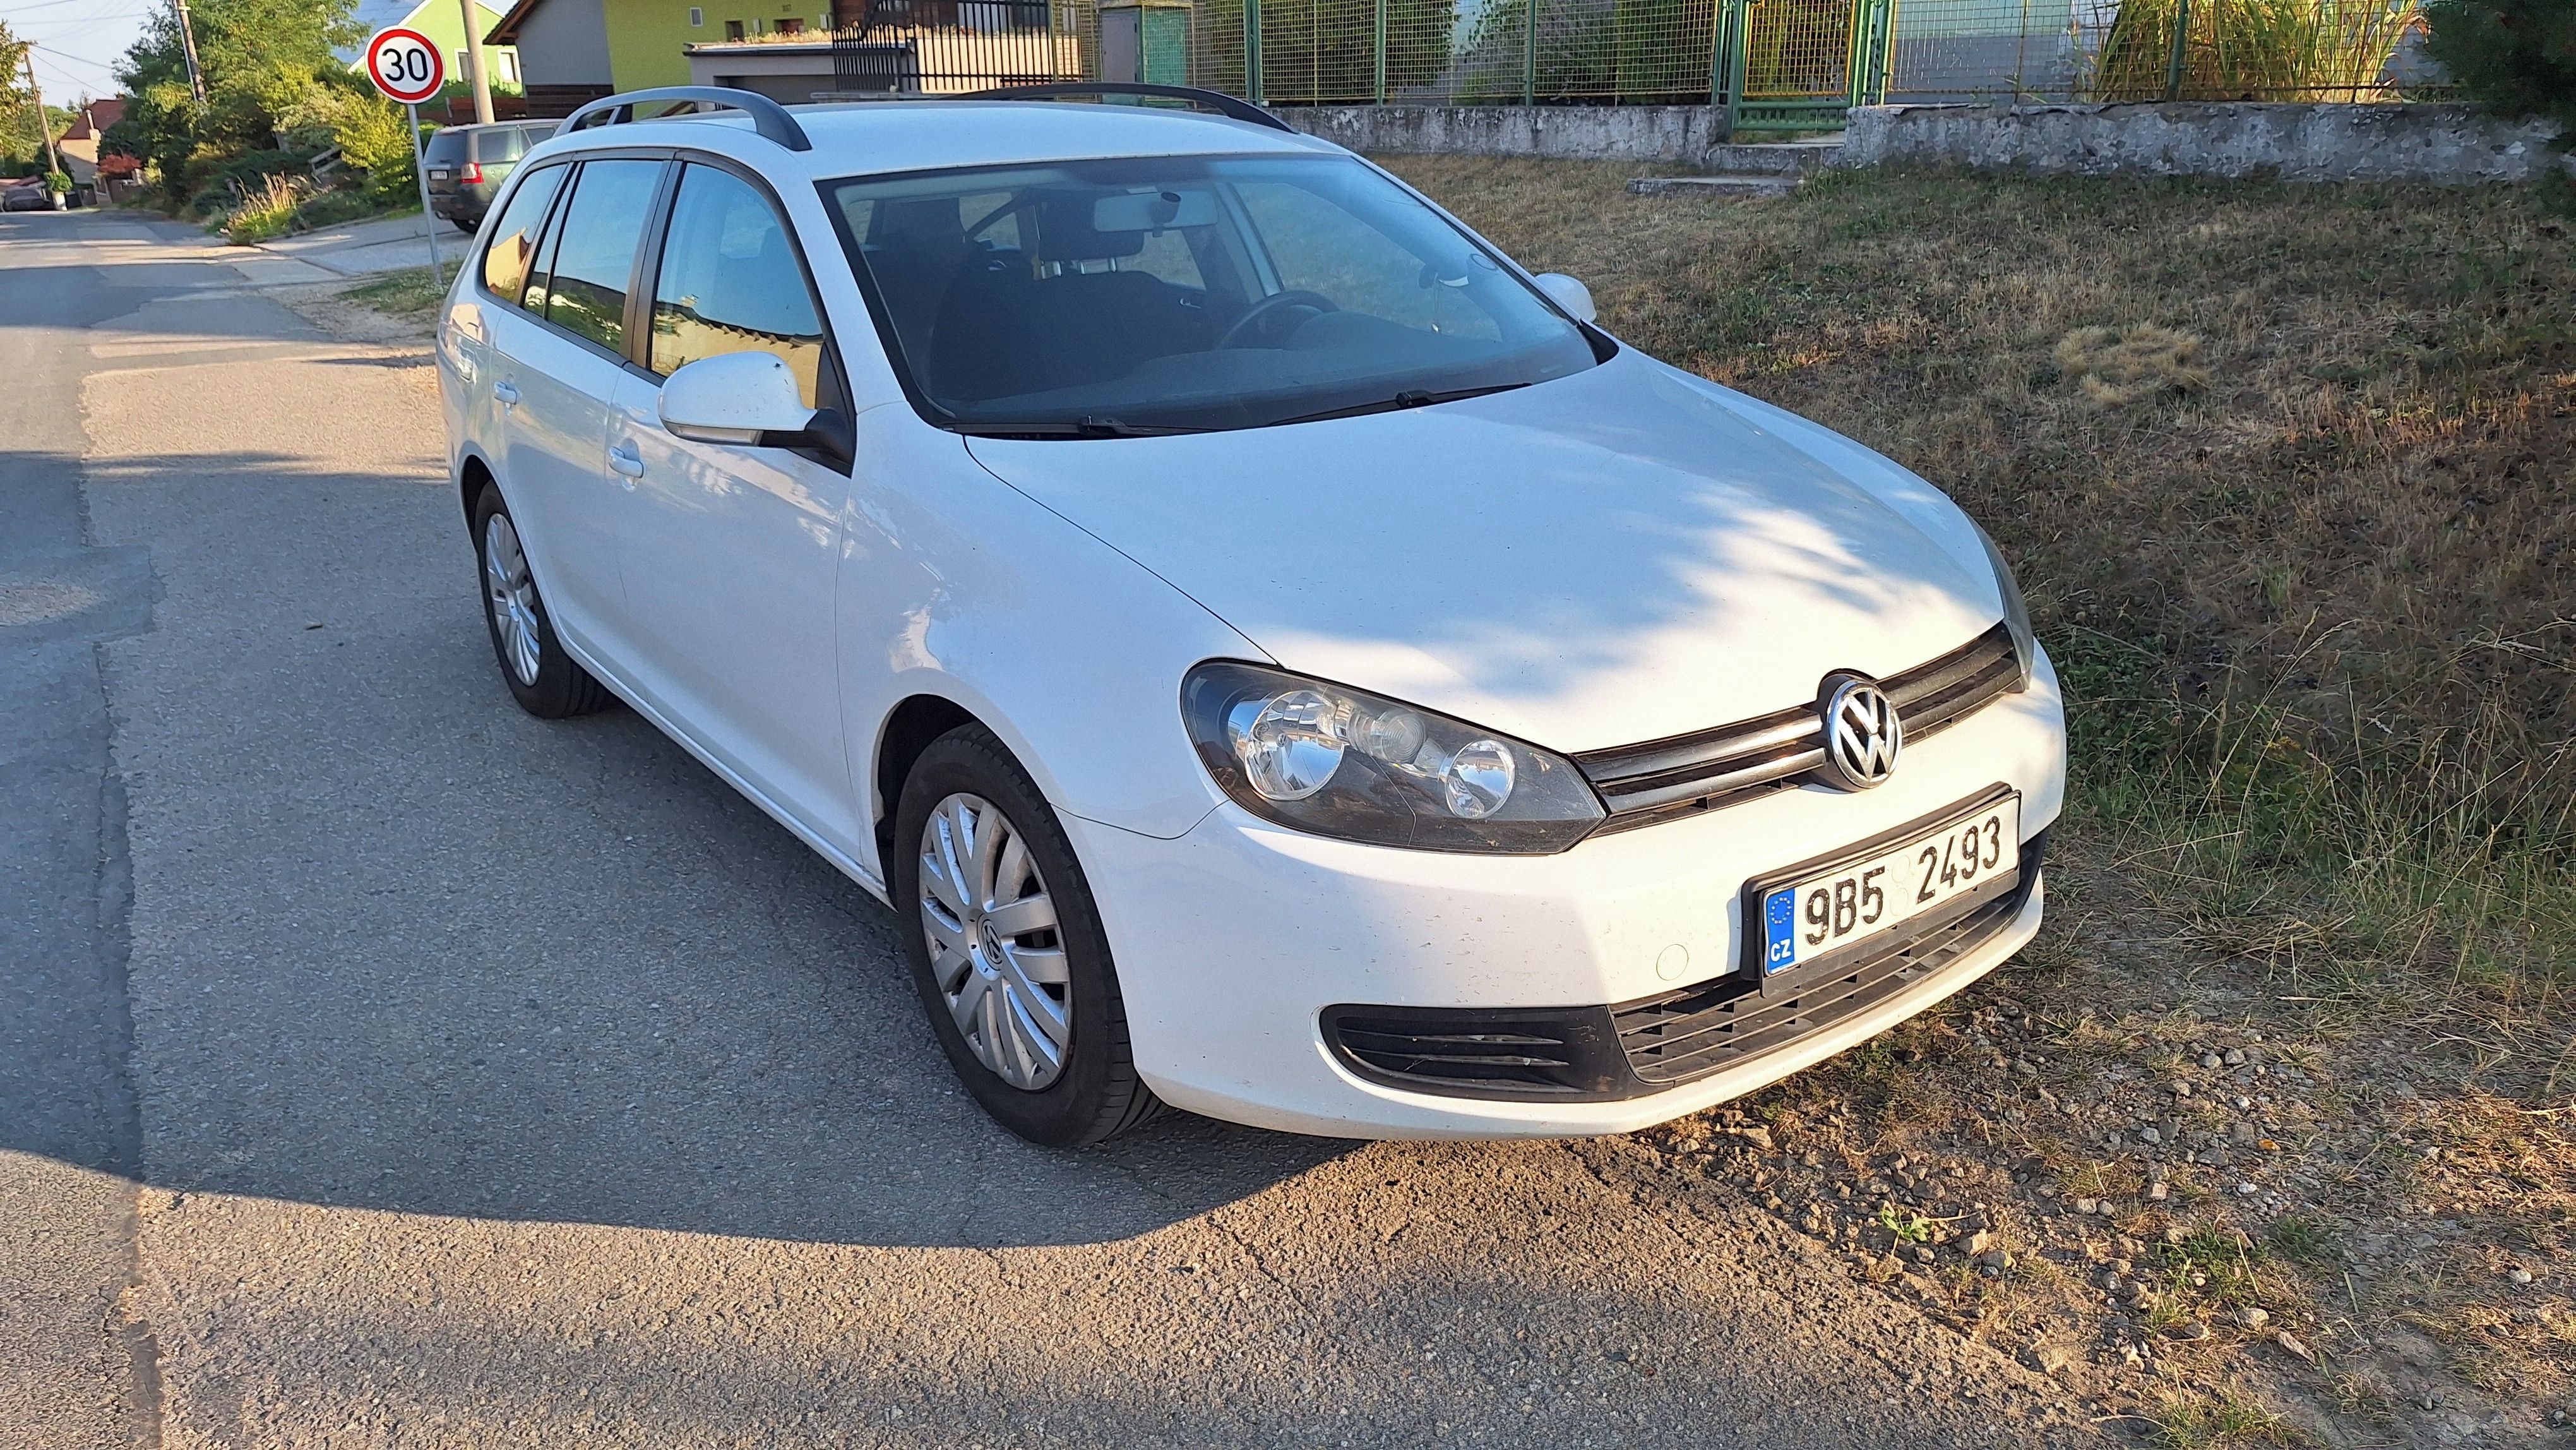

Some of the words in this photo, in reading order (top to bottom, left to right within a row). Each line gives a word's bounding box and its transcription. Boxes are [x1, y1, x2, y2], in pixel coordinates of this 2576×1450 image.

[382, 49, 428, 81] 30
[1833, 683, 1899, 784] VW
[1805, 866, 1885, 945] 9B5
[1916, 815, 2001, 904] 2493
[980, 918, 1002, 966] VW
[1770, 938, 1791, 962] CZ
